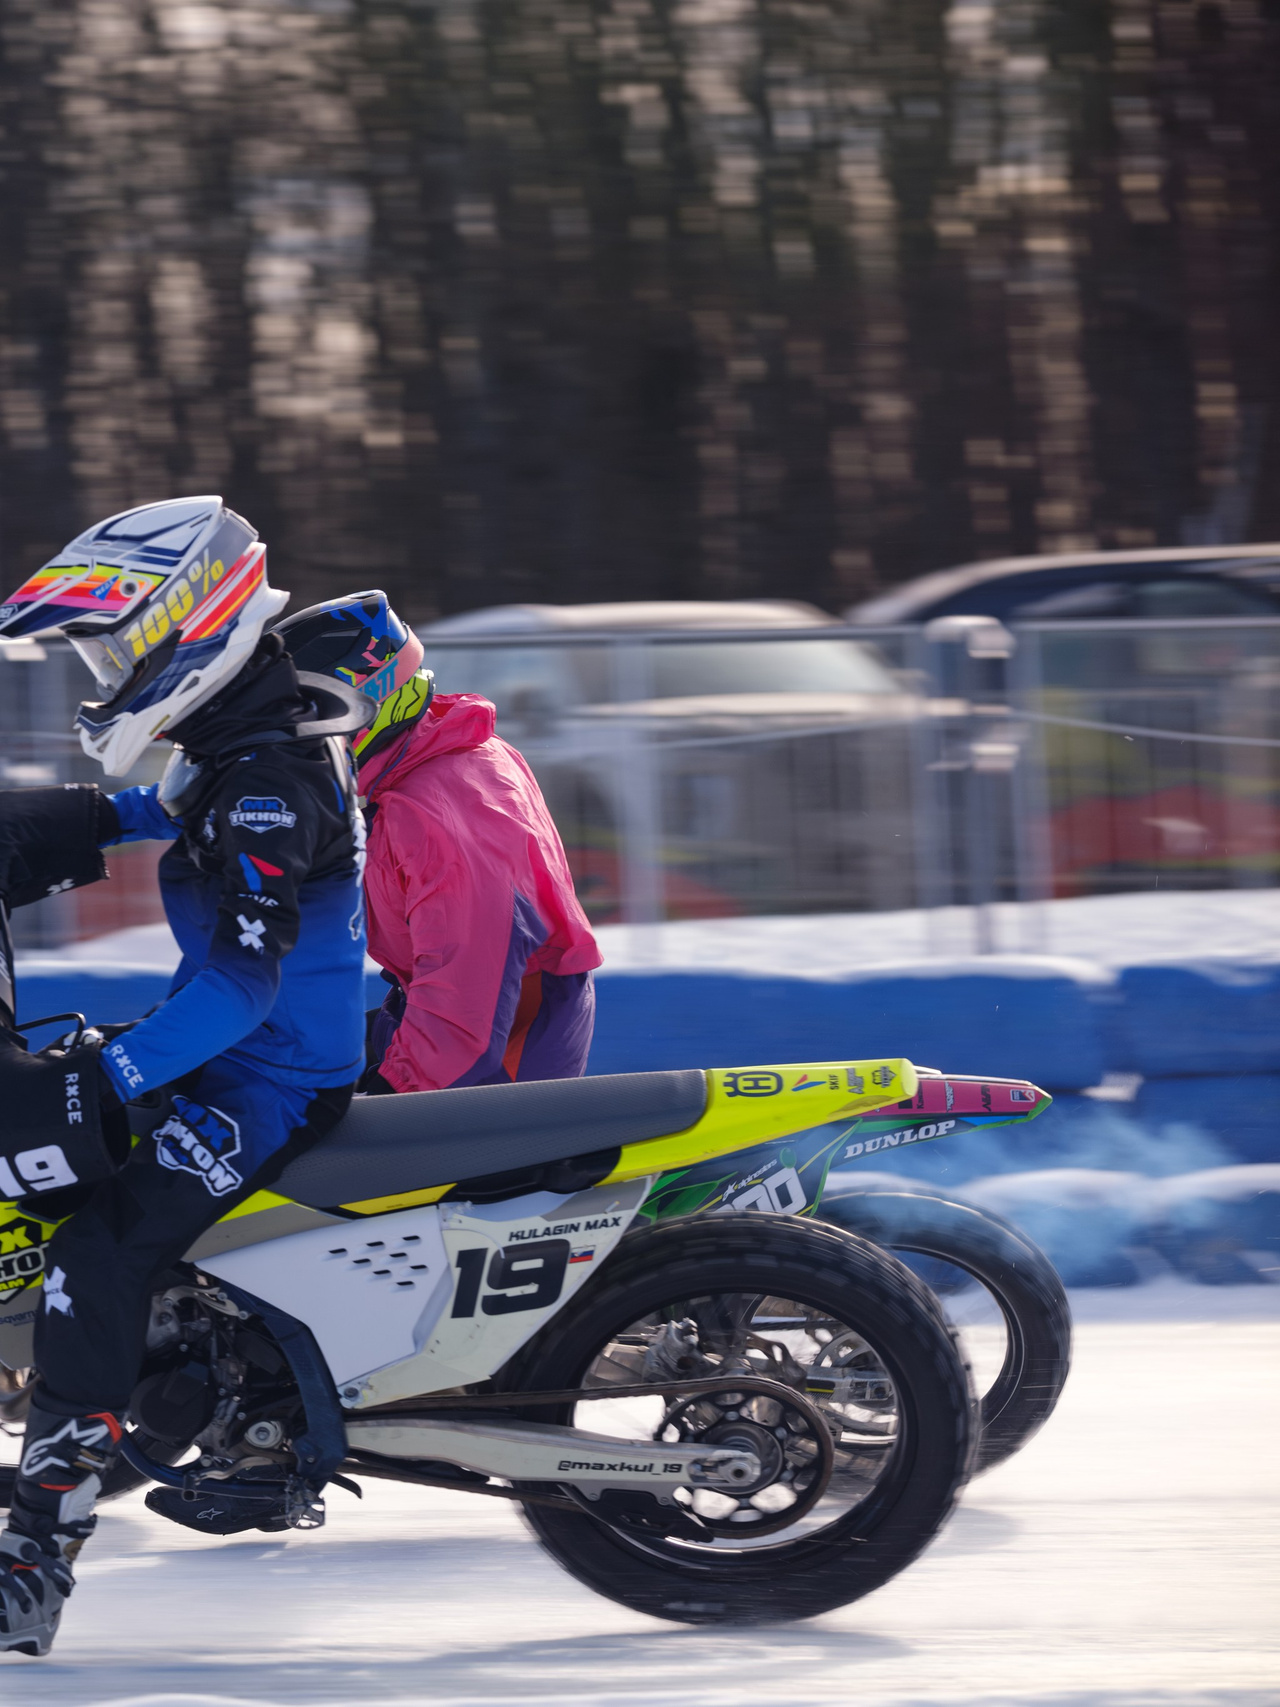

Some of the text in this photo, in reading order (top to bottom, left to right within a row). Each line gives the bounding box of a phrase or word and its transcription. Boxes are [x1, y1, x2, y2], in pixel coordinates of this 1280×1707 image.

[123, 547, 225, 658] 100%
[358, 658, 399, 702] ATT
[230, 811, 295, 825] TIKHON
[243, 800, 280, 811] MX
[843, 1119, 956, 1159] DUNLOP
[508, 1216, 623, 1242] KULAGIN MAX
[450, 1238, 571, 1319] 19
[557, 1460, 684, 1476] @maxkul_19
